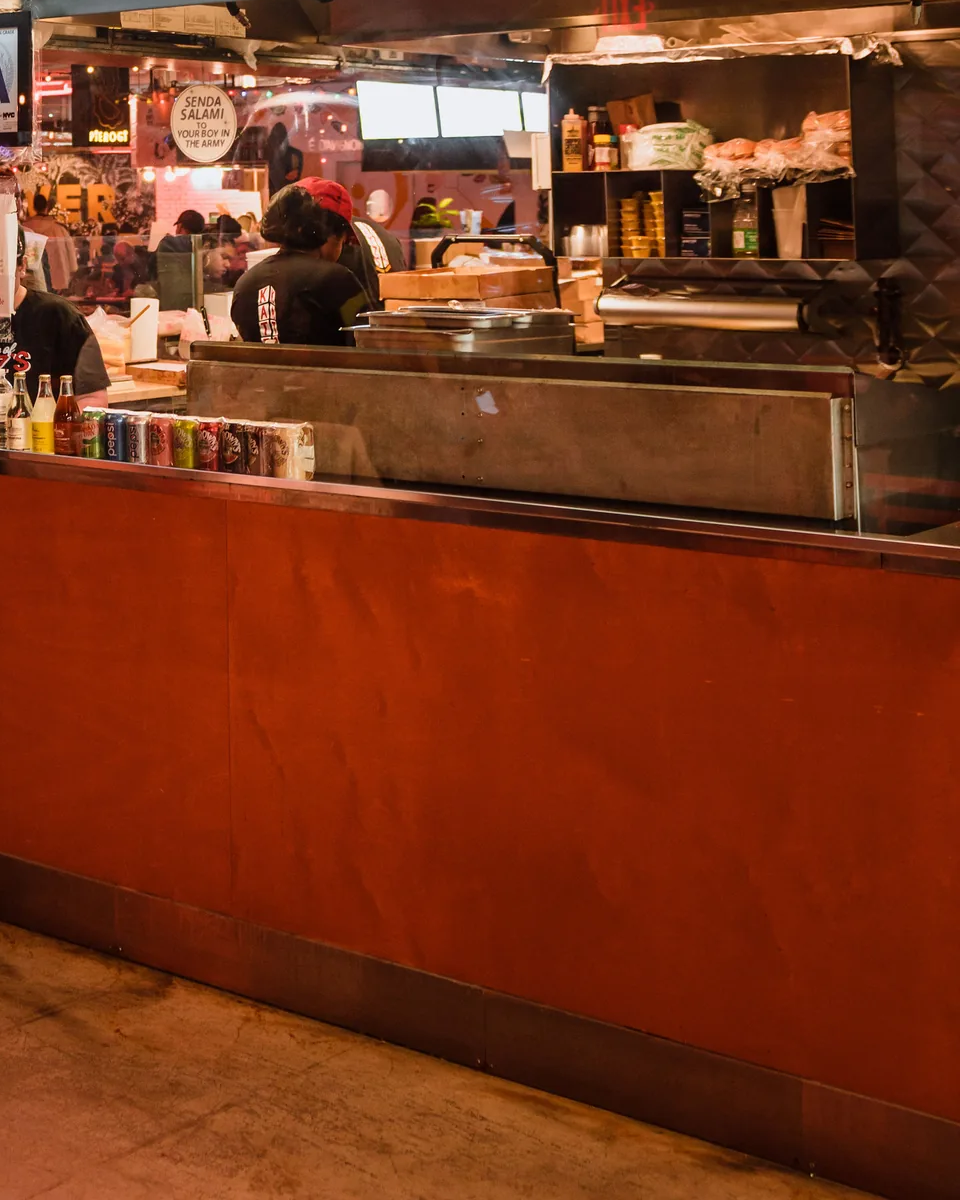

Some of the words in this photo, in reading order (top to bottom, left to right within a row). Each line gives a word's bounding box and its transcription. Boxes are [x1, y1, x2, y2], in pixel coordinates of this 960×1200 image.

[181, 109, 224, 120] SALAMI
[178, 130, 199, 138] YOUR
[201, 129, 218, 137] BOY
[221, 129, 230, 137] IN
[186, 140, 199, 148] THE
[202, 140, 225, 148] ARMY
[2, 342, 17, 354] of
[106, 422, 117, 456] pepsi
